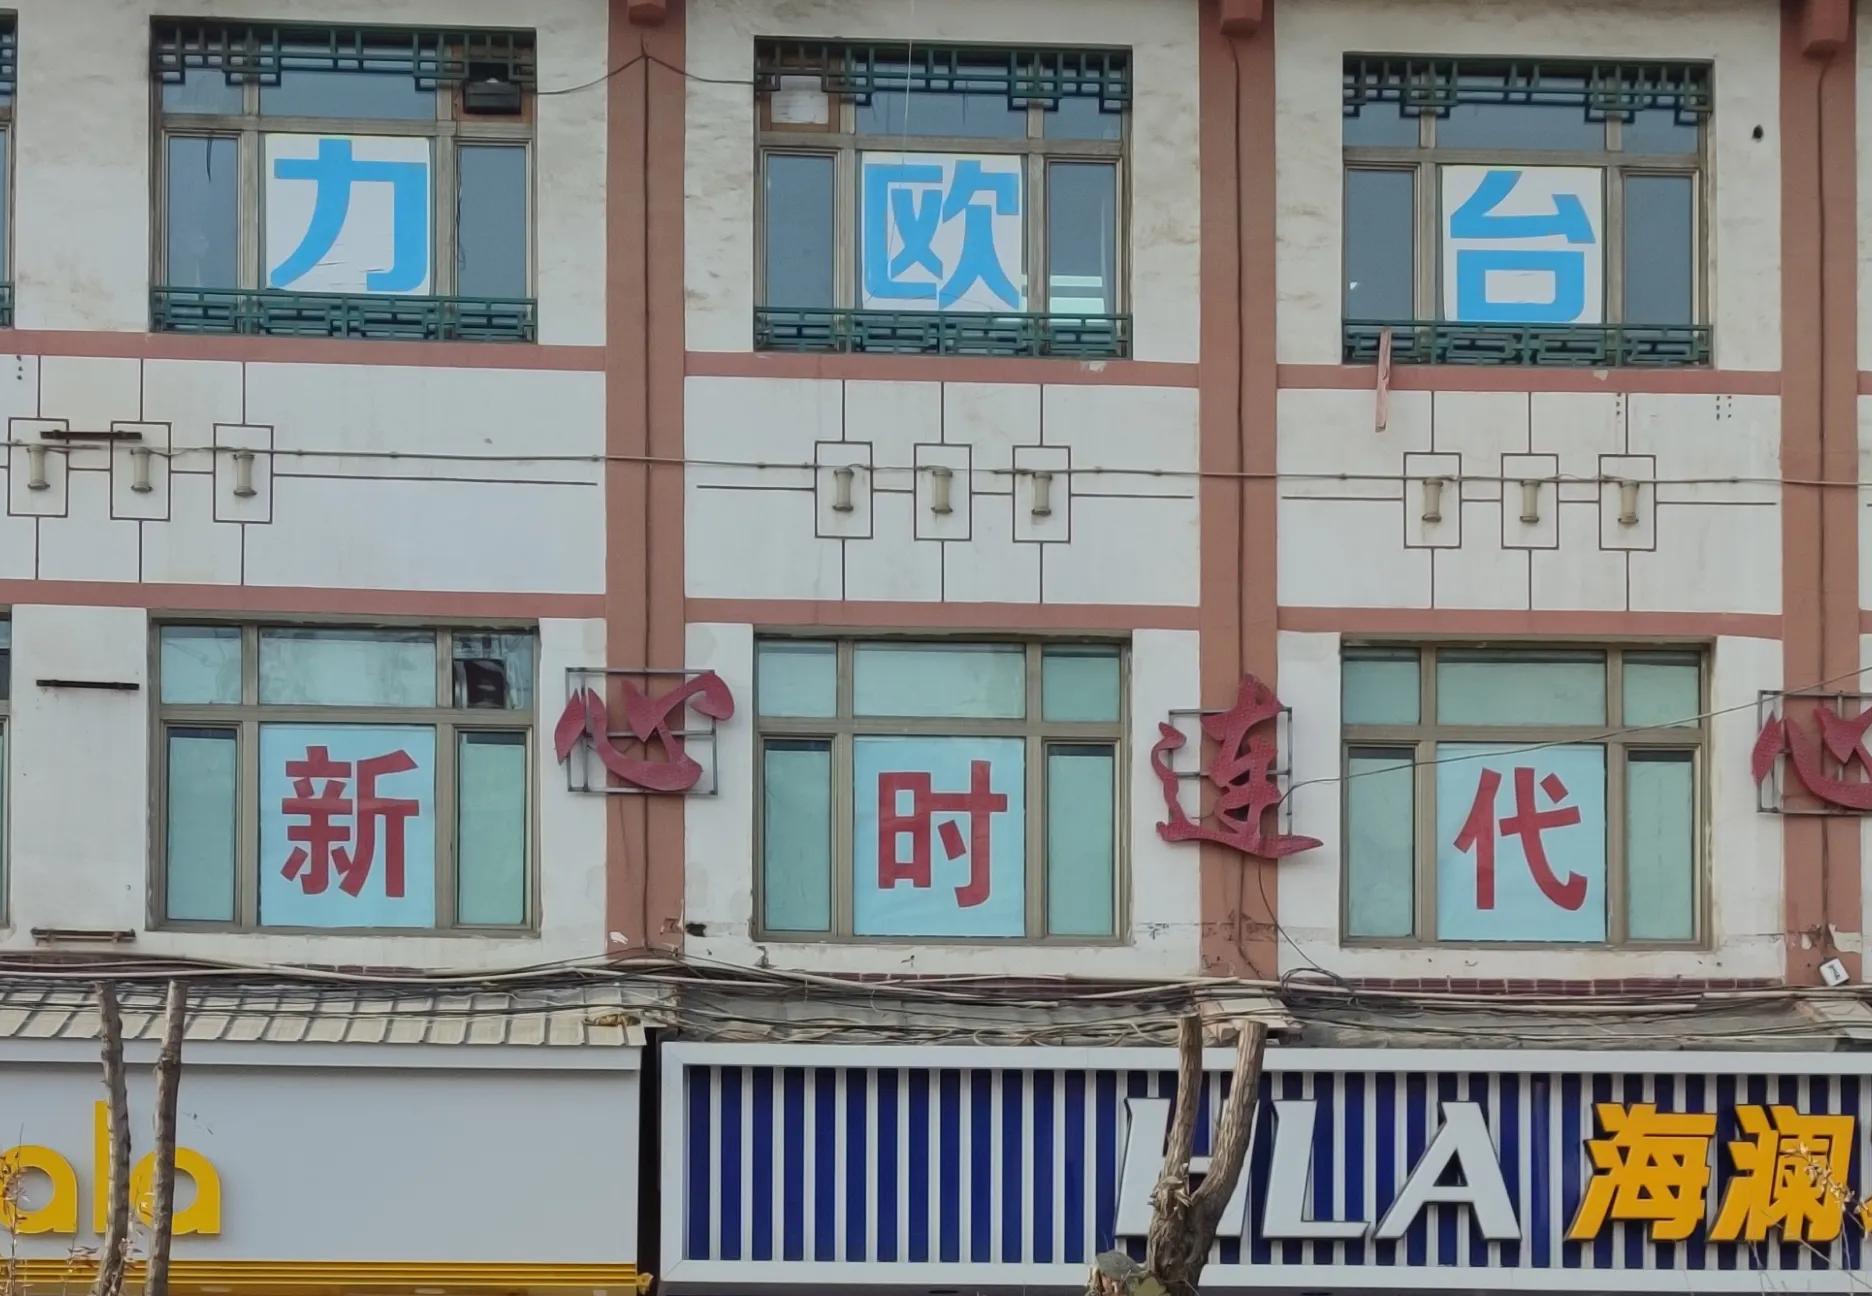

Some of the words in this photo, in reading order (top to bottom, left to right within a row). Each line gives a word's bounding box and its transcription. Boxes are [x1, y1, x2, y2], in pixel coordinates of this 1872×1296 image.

[271, 138, 429, 294] 力
[863, 160, 1021, 309] 欧
[1450, 170, 1596, 322] 台
[281, 745, 420, 898] 新
[877, 760, 1008, 908] 时
[1454, 767, 1588, 911] 代
[1114, 1097, 1522, 1240] HLA
